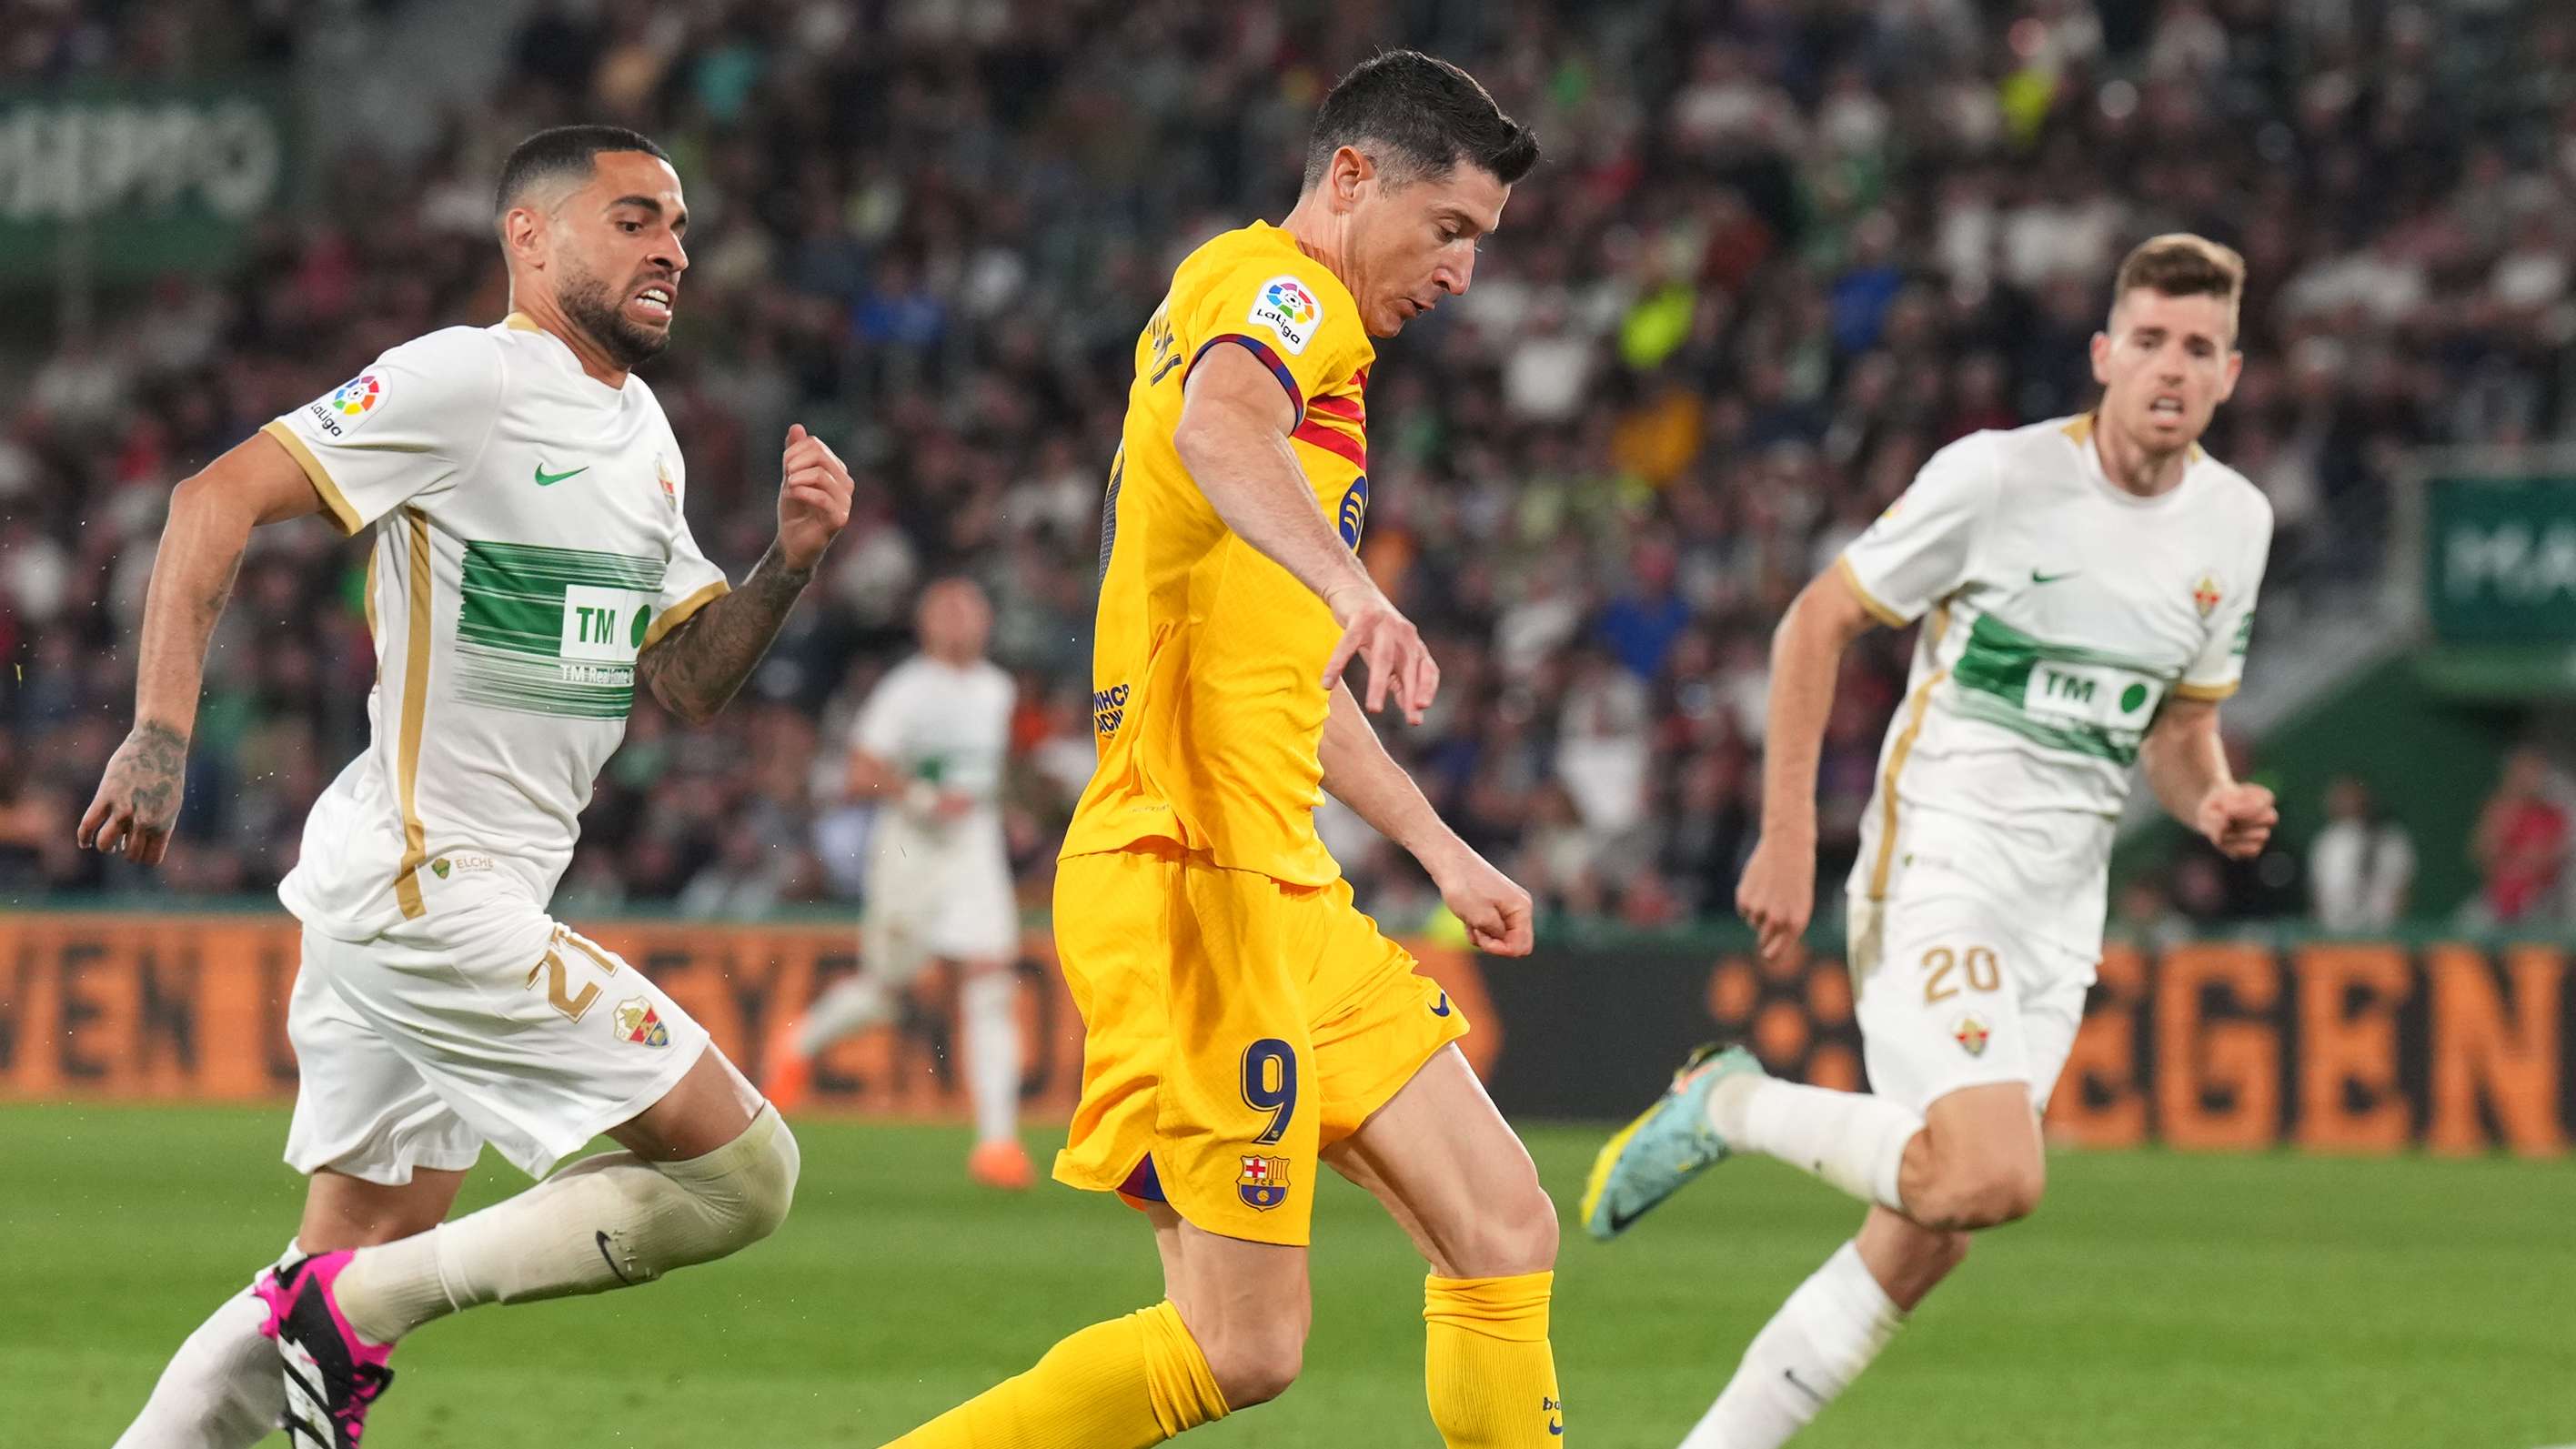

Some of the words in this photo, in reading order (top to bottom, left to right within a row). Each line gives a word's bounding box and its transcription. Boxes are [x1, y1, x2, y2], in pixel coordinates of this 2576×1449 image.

[1256, 308, 1301, 345] LaLiga
[310, 402, 343, 438] LaLiga
[576, 607, 616, 645] TM
[2045, 669, 2097, 704] TM
[526, 925, 619, 1023] 21
[1920, 946, 2001, 1007] 20
[1239, 1038, 1297, 1145] 9
